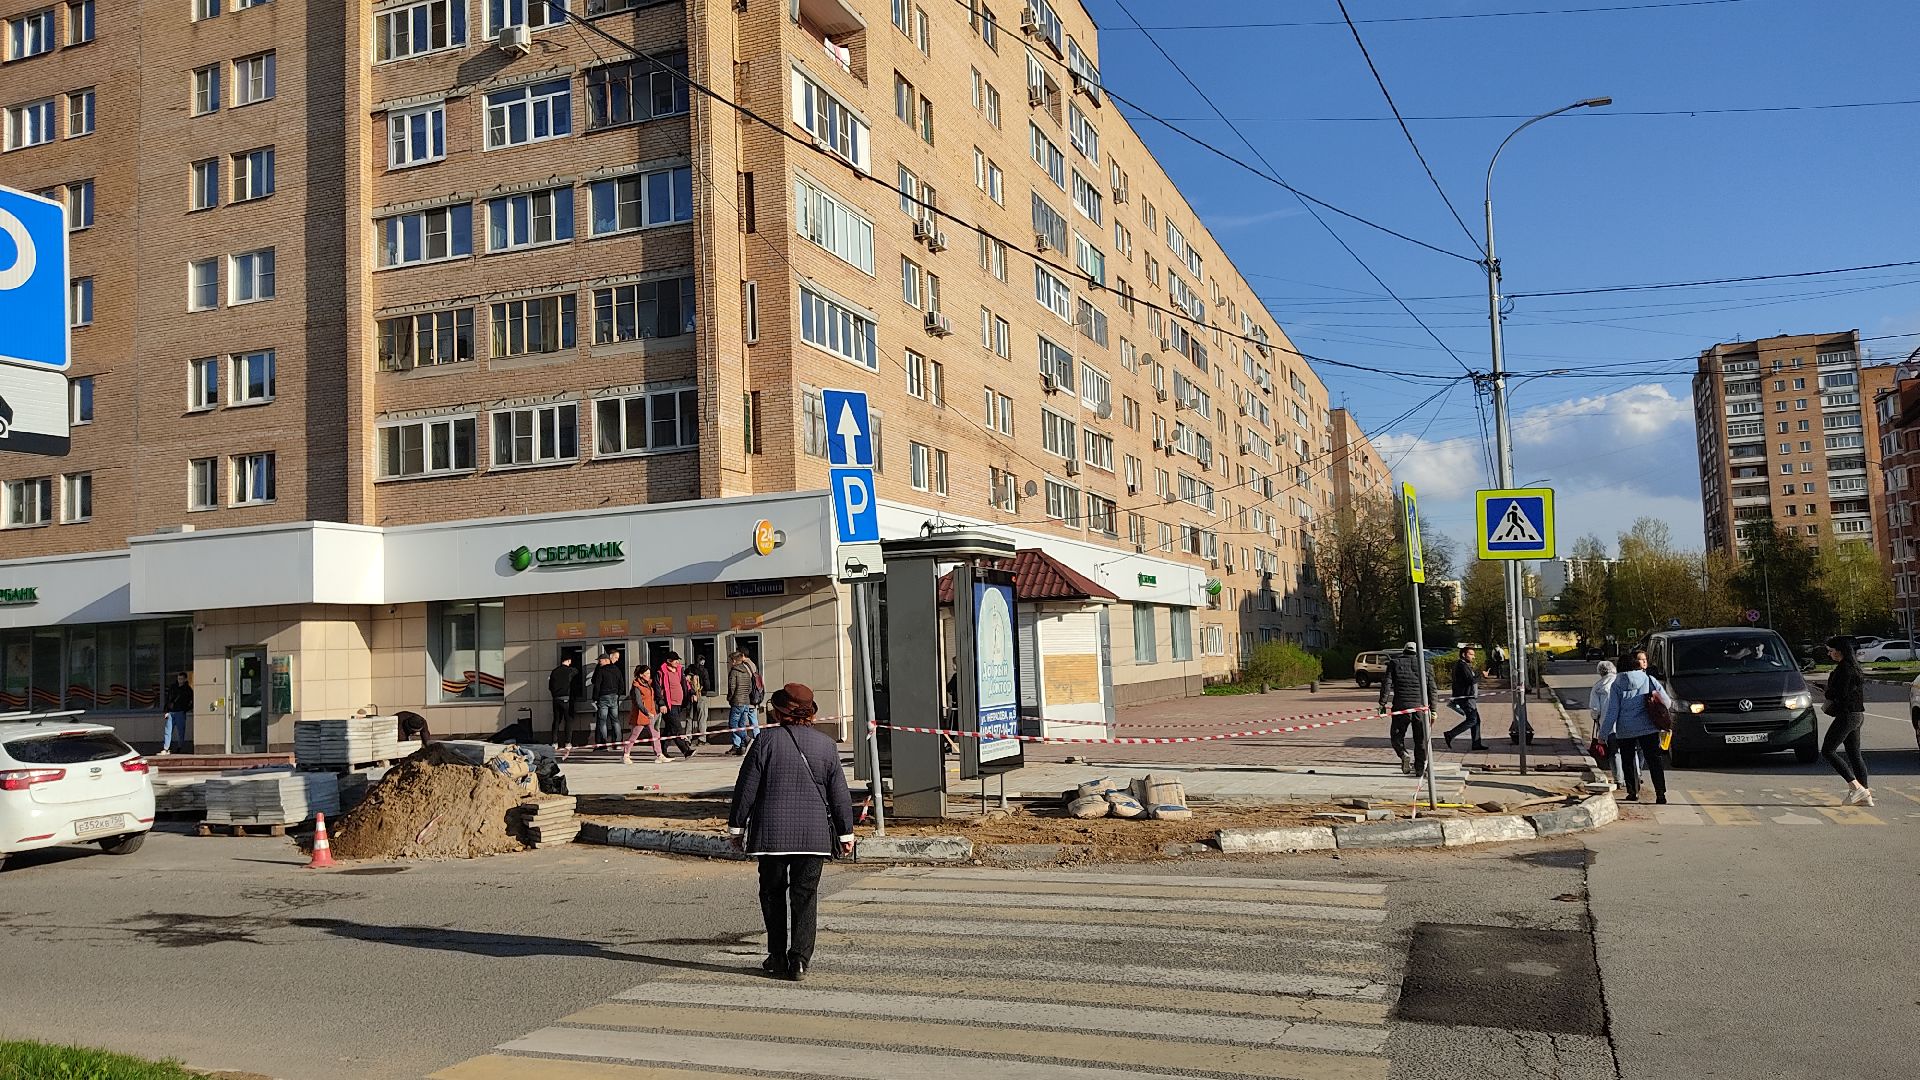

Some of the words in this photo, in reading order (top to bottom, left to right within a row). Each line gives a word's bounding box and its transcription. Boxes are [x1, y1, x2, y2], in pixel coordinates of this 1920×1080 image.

[842, 476, 868, 535] P
[760, 528, 773, 542] 24
[535, 540, 625, 563] СБЕРБАНК
